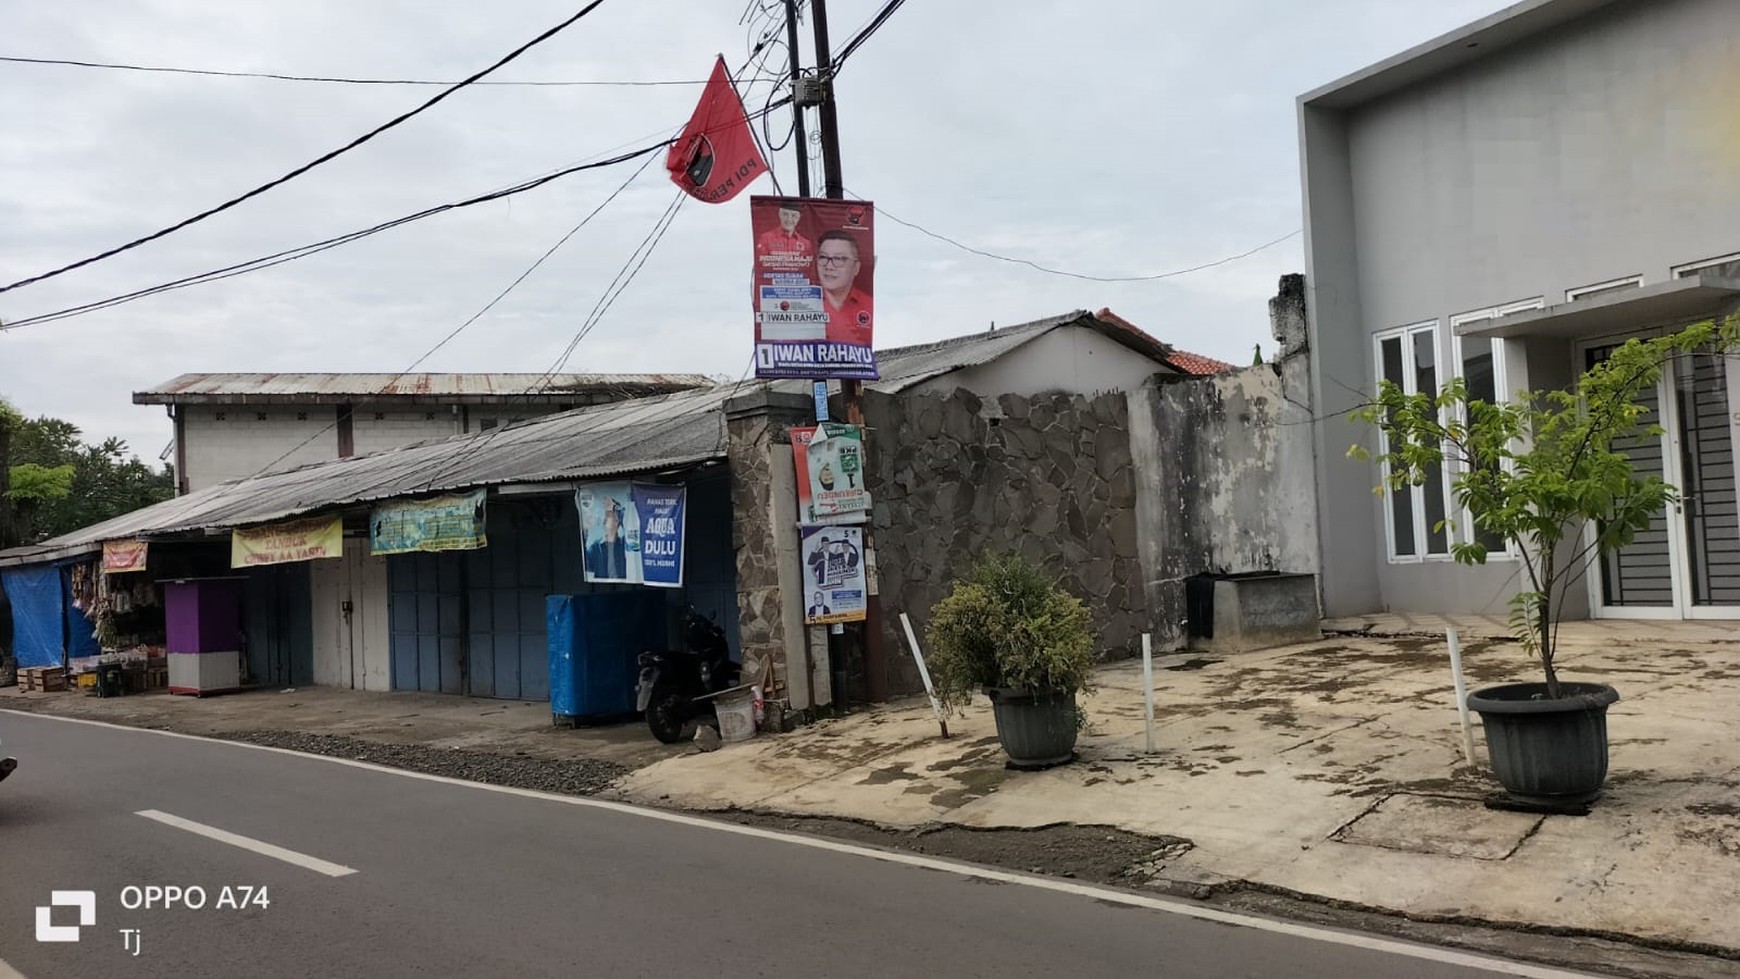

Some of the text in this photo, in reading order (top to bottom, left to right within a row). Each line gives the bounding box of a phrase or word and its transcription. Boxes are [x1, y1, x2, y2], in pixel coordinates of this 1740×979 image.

[758, 313, 829, 322] 1 IWAN RAHAYU
[761, 344, 872, 365] 1 IWAN RAHAYU
[645, 518, 676, 537] AQUA
[644, 540, 676, 555] DULU
